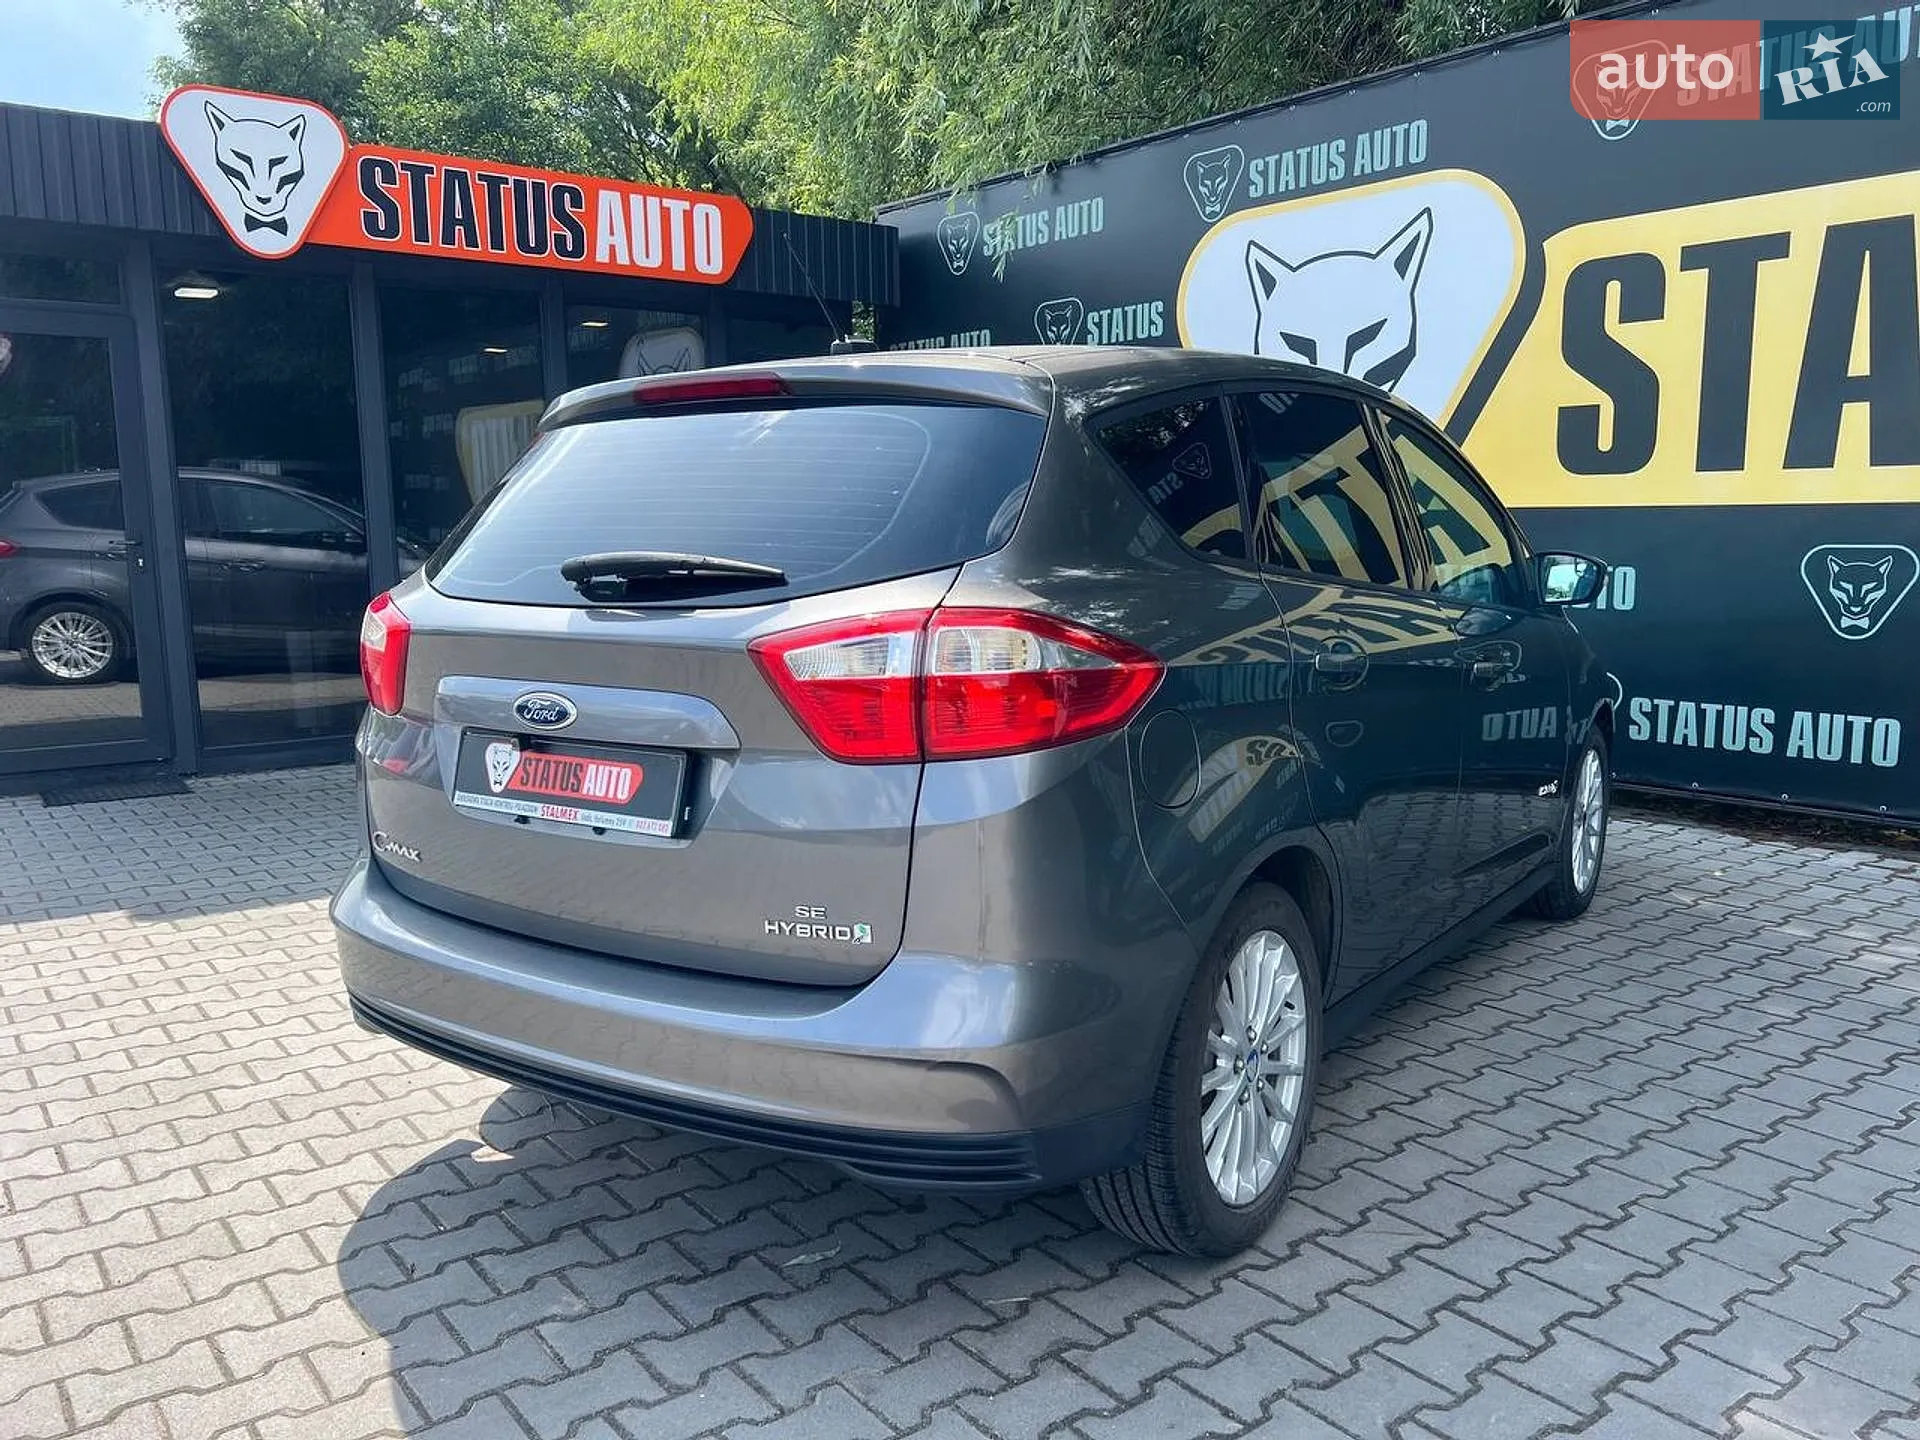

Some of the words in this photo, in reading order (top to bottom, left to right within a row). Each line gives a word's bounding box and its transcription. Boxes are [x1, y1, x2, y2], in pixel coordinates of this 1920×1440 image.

[1848, 3, 1920, 72] AU
[1249, 139, 1346, 199] STATUS
[1353, 119, 1428, 177] AUTO
[357, 155, 586, 262] STATUS
[595, 189, 724, 276] AUTO
[1054, 197, 1105, 242] AUTO
[1086, 300, 1164, 346] STATUS
[1556, 213, 1920, 476] STA
[523, 699, 560, 722] Ford
[1628, 696, 1776, 755] STATUS
[1786, 710, 1901, 768] AUTO
[520, 757, 583, 794] STATUS
[582, 763, 632, 801] AUTO
[764, 920, 851, 941] HYBRID
[794, 905, 826, 919] SE
